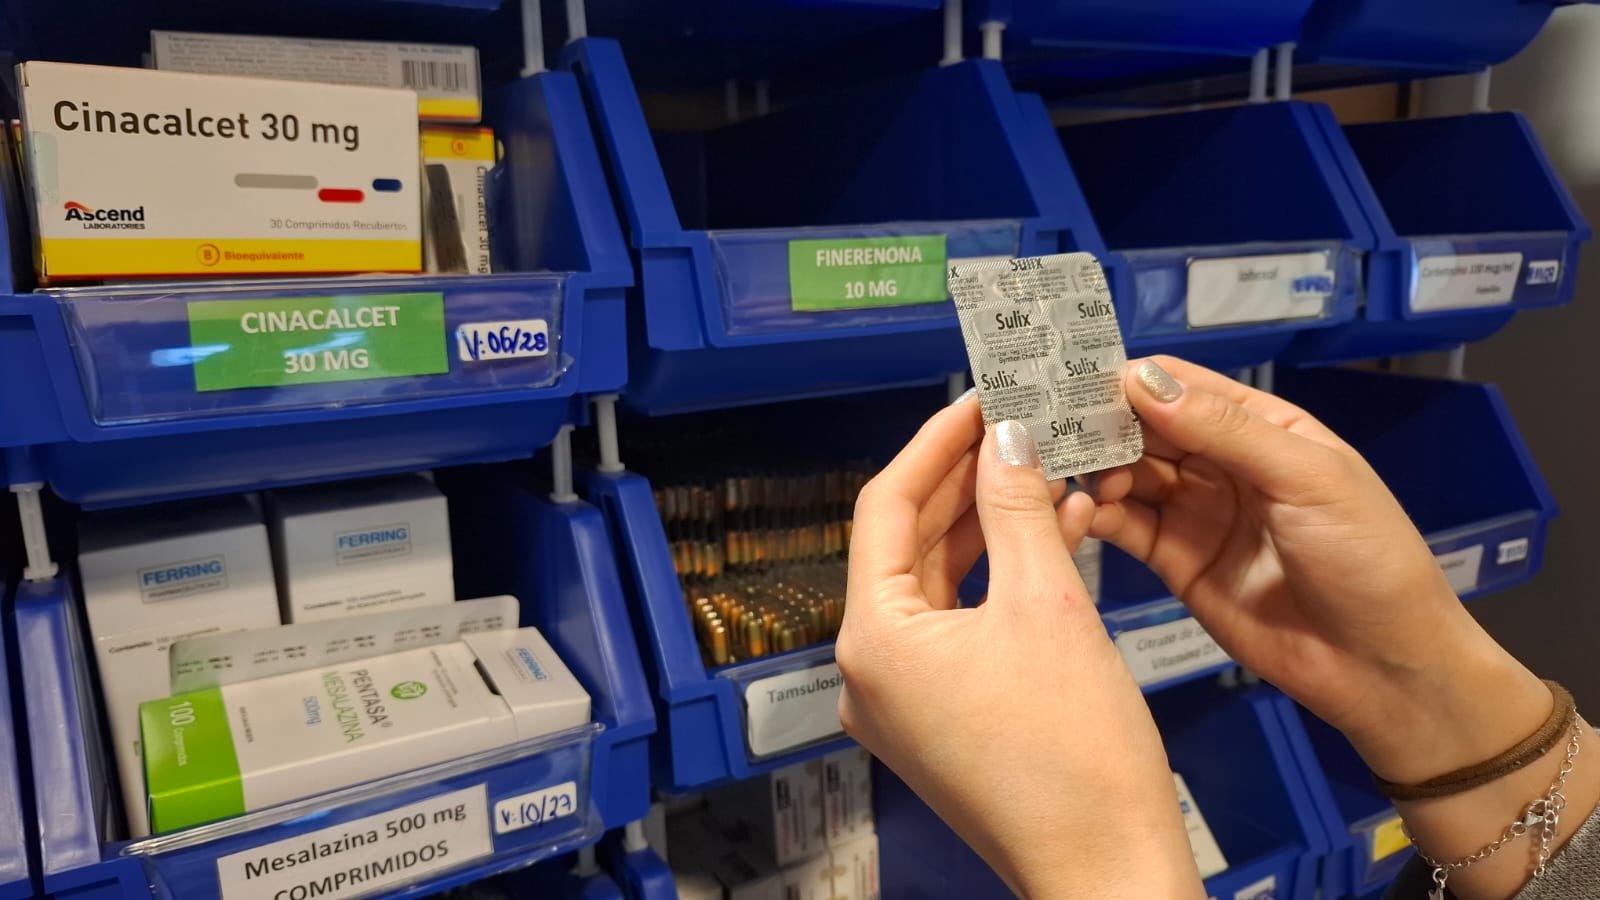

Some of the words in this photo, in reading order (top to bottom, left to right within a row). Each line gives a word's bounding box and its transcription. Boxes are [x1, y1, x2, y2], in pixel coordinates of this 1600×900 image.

[53, 100, 250, 140] Cinacalcet
[261, 113, 299, 142] 30
[311, 122, 360, 152] mg
[65, 202, 145, 222] Ascend
[269, 219, 283, 229] 30
[285, 219, 350, 232] Comprimidos
[353, 220, 408, 232] Recubiertos
[223, 250, 305, 262] Bioequivalente
[477, 255, 489, 274] mg
[815, 246, 923, 267] FINERENONA
[845, 281, 865, 299] 10
[869, 280, 897, 298] MG
[240, 305, 400, 335] CINACALCET
[996, 310, 1031, 330] Sulix
[1078, 300, 1112, 319] Sulix
[462, 326, 548, 361] V:06/28
[284, 352, 316, 375] 30
[324, 348, 370, 372] MG
[1065, 357, 1100, 377] Sulix
[981, 370, 1018, 390] Sulix
[1051, 416, 1084, 437] Sulix
[338, 528, 407, 549] FERRING
[143, 559, 223, 586] FERRING
[168, 701, 195, 726] 100
[321, 671, 364, 743] MESALAZINA
[244, 832, 379, 880] Mesalazina
[385, 812, 427, 839] 500
[433, 804, 467, 825] mg
[274, 839, 449, 900] COMPRIMIDOS
